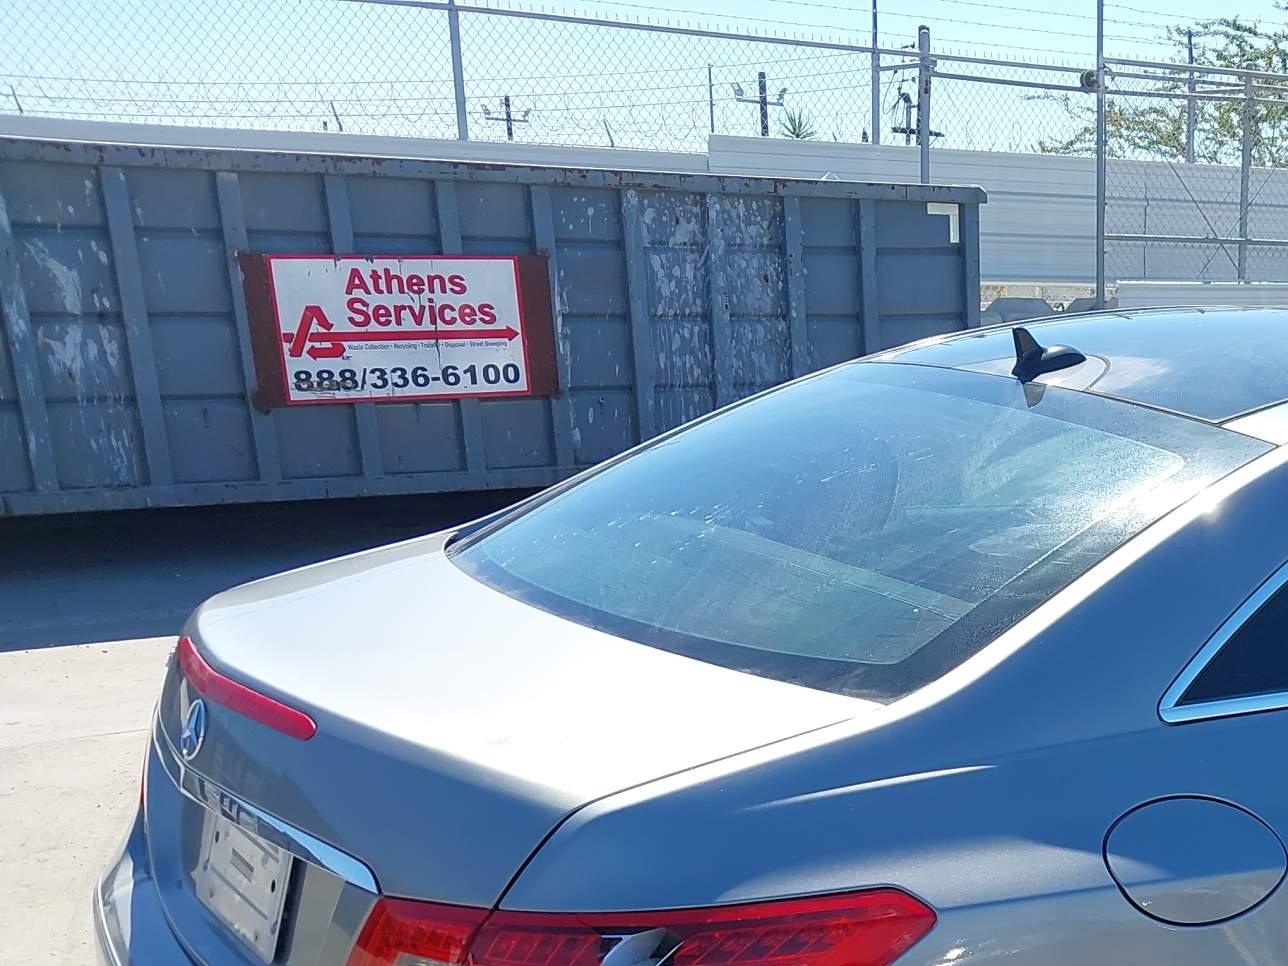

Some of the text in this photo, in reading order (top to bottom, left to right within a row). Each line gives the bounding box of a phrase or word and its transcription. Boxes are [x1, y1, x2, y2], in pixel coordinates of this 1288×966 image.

[345, 267, 467, 296] Athens
[347, 297, 497, 328] Services
[393, 342, 417, 351] Recycling
[293, 362, 521, 392] 888/336-6100
